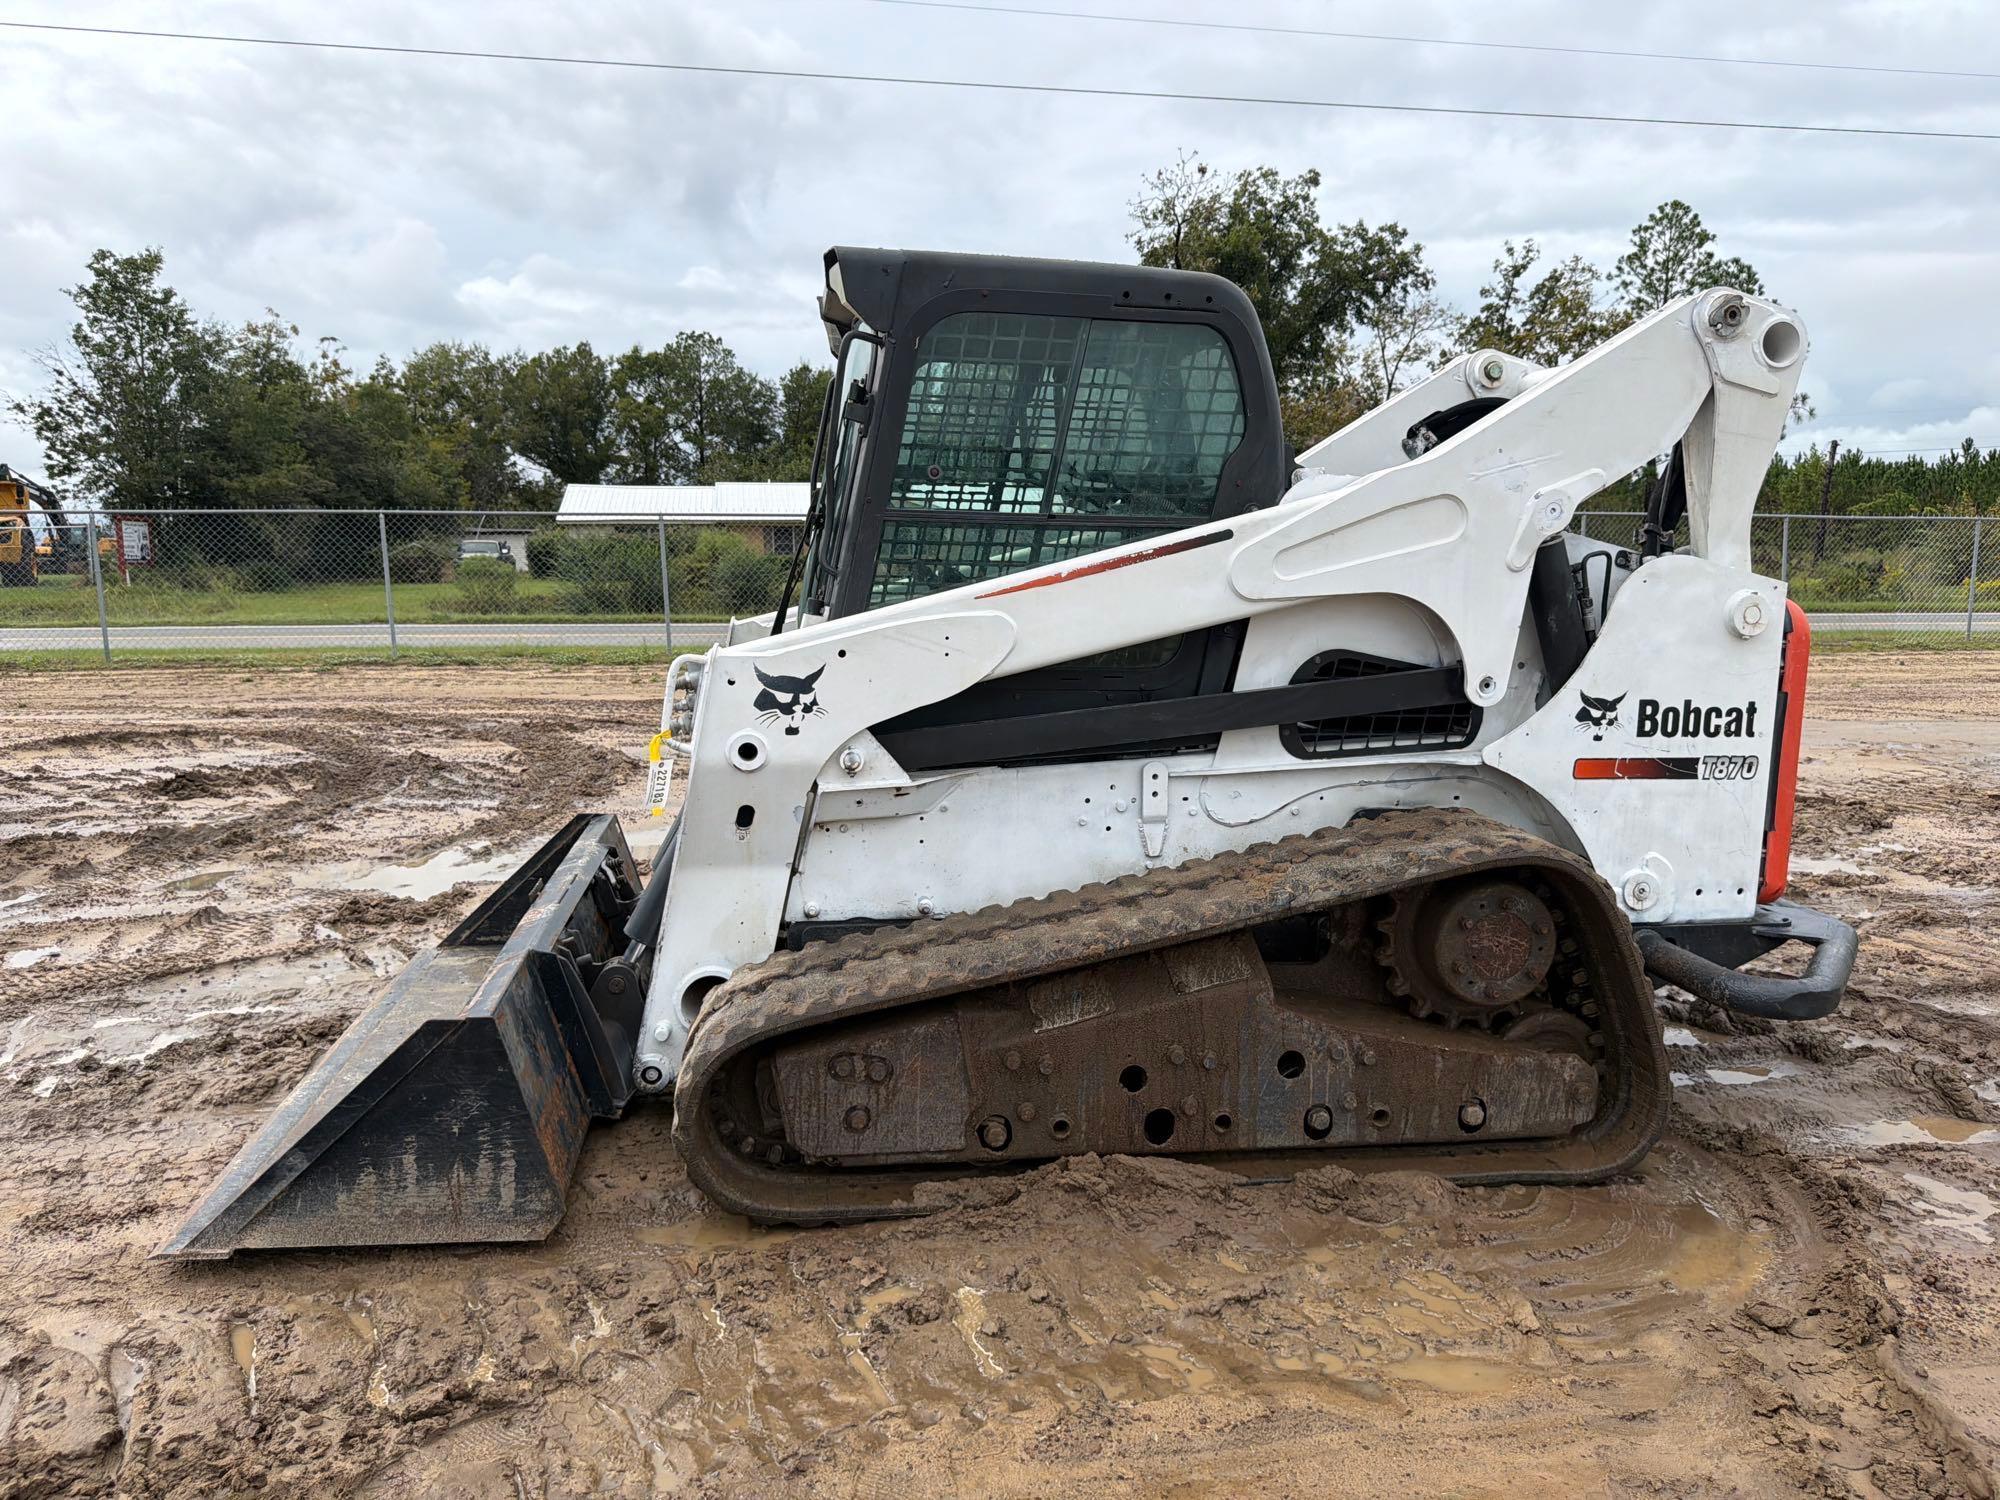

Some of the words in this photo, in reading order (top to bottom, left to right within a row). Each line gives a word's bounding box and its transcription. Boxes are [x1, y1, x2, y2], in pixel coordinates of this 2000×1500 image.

[1636, 699, 1757, 738] Bobcat
[1702, 755, 1759, 780] T870
[653, 770, 667, 803] 227183
